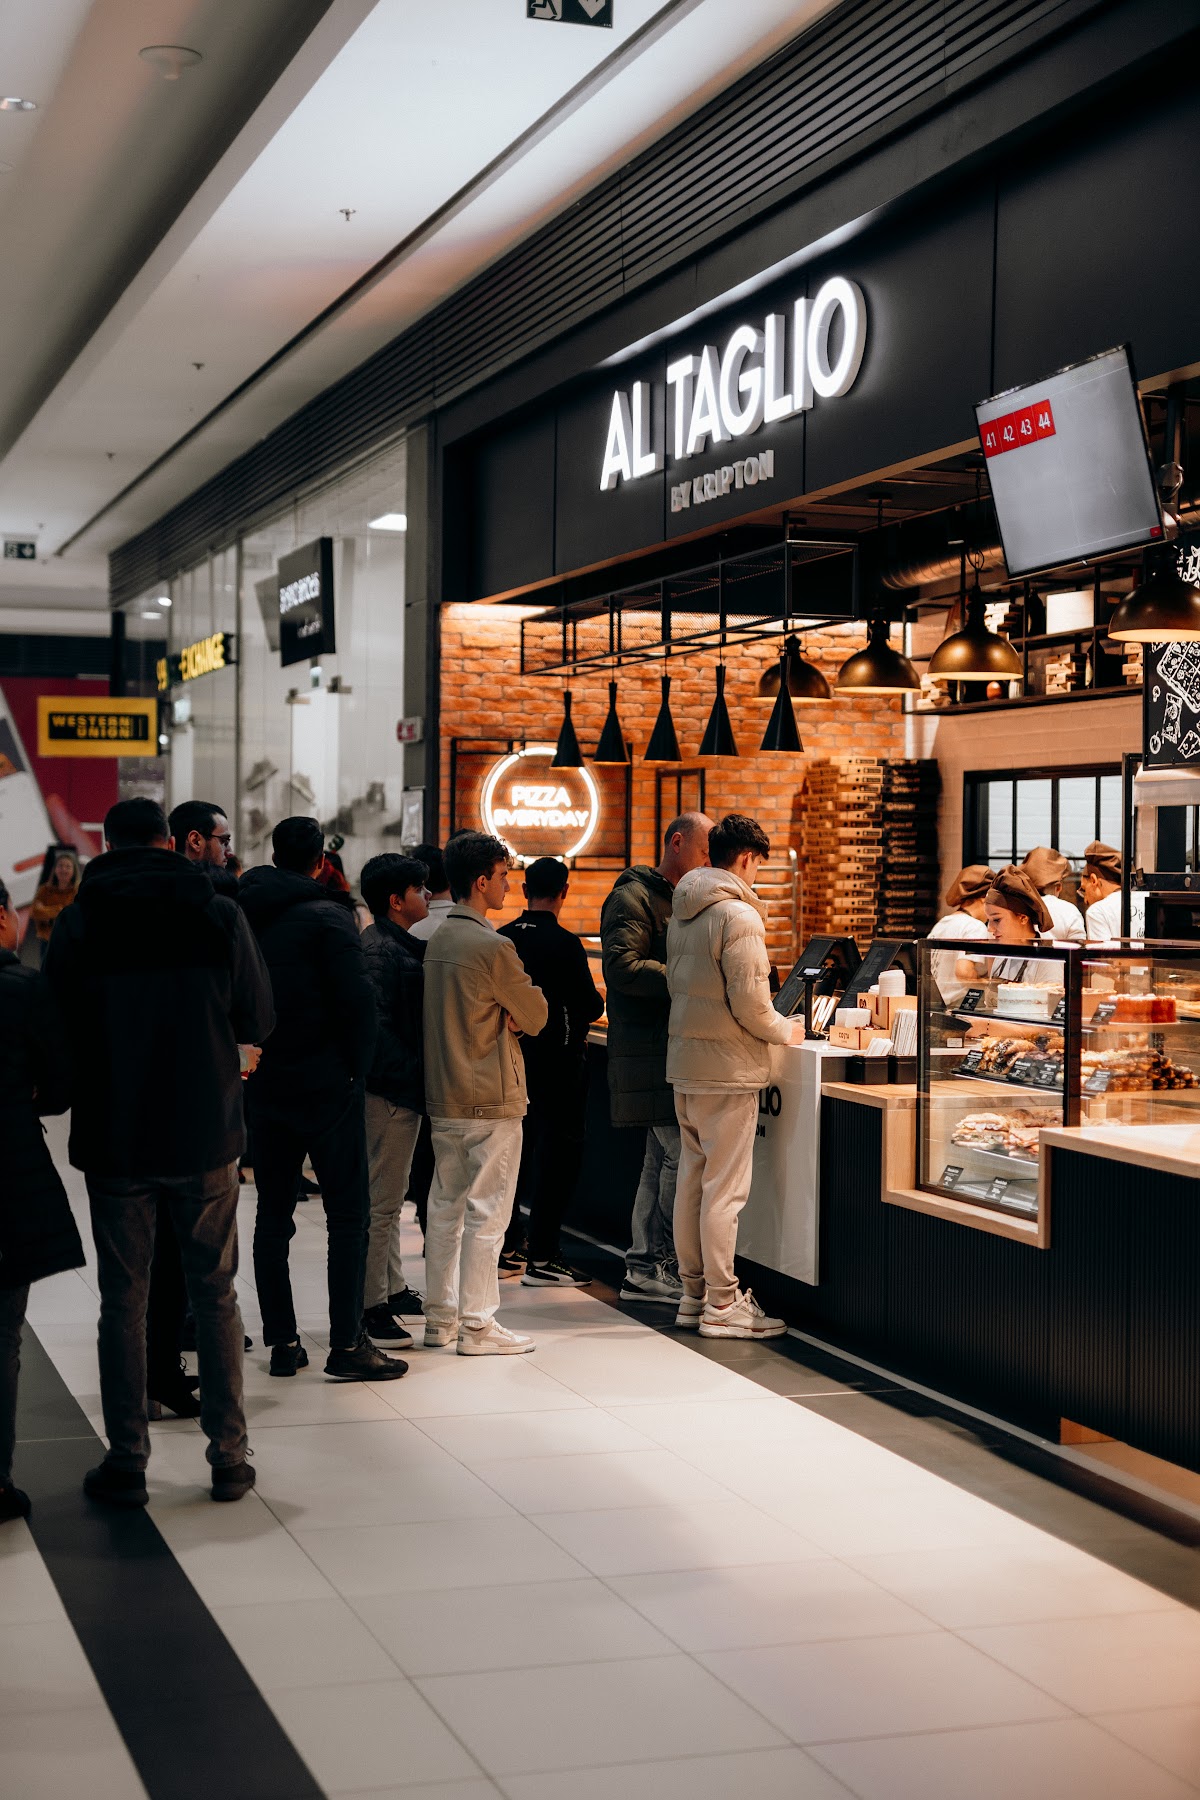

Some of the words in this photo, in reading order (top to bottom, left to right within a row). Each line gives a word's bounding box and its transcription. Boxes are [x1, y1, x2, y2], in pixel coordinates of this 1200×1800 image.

[600, 380, 664, 491] AL
[667, 276, 867, 460] TAGLIO
[986, 432, 997, 449] 41
[1003, 425, 1016, 443] 42
[1020, 418, 1033, 436] 43
[1038, 412, 1051, 430] 44
[671, 481, 692, 512] BY
[693, 449, 774, 505] KRIPTON
[52, 715, 130, 727] WESTERN
[76, 726, 130, 738] UNION
[511, 785, 572, 807] PIZZA
[493, 808, 589, 827] EVERYDAY
